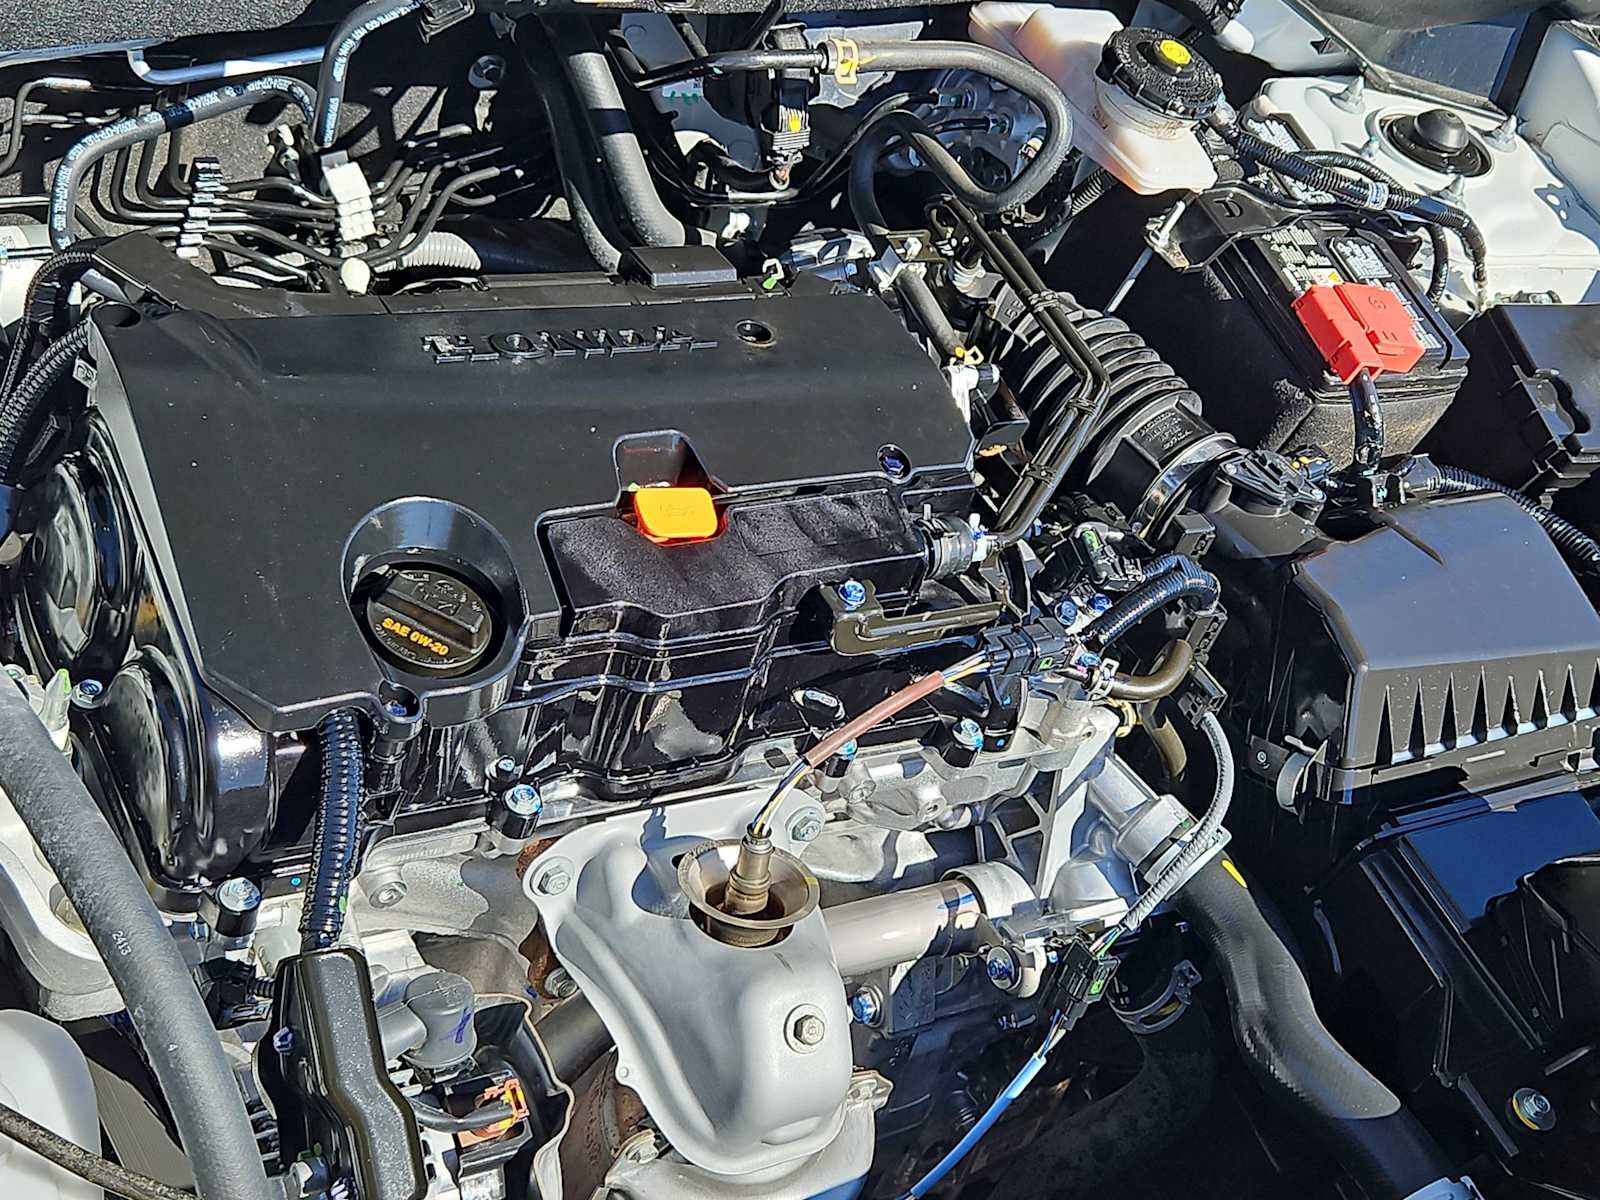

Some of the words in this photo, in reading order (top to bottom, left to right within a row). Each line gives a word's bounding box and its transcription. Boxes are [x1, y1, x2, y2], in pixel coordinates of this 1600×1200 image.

[382, 618, 411, 637] SAE
[410, 632, 449, 655] 0W-20
[112, 931, 132, 956] 2413
